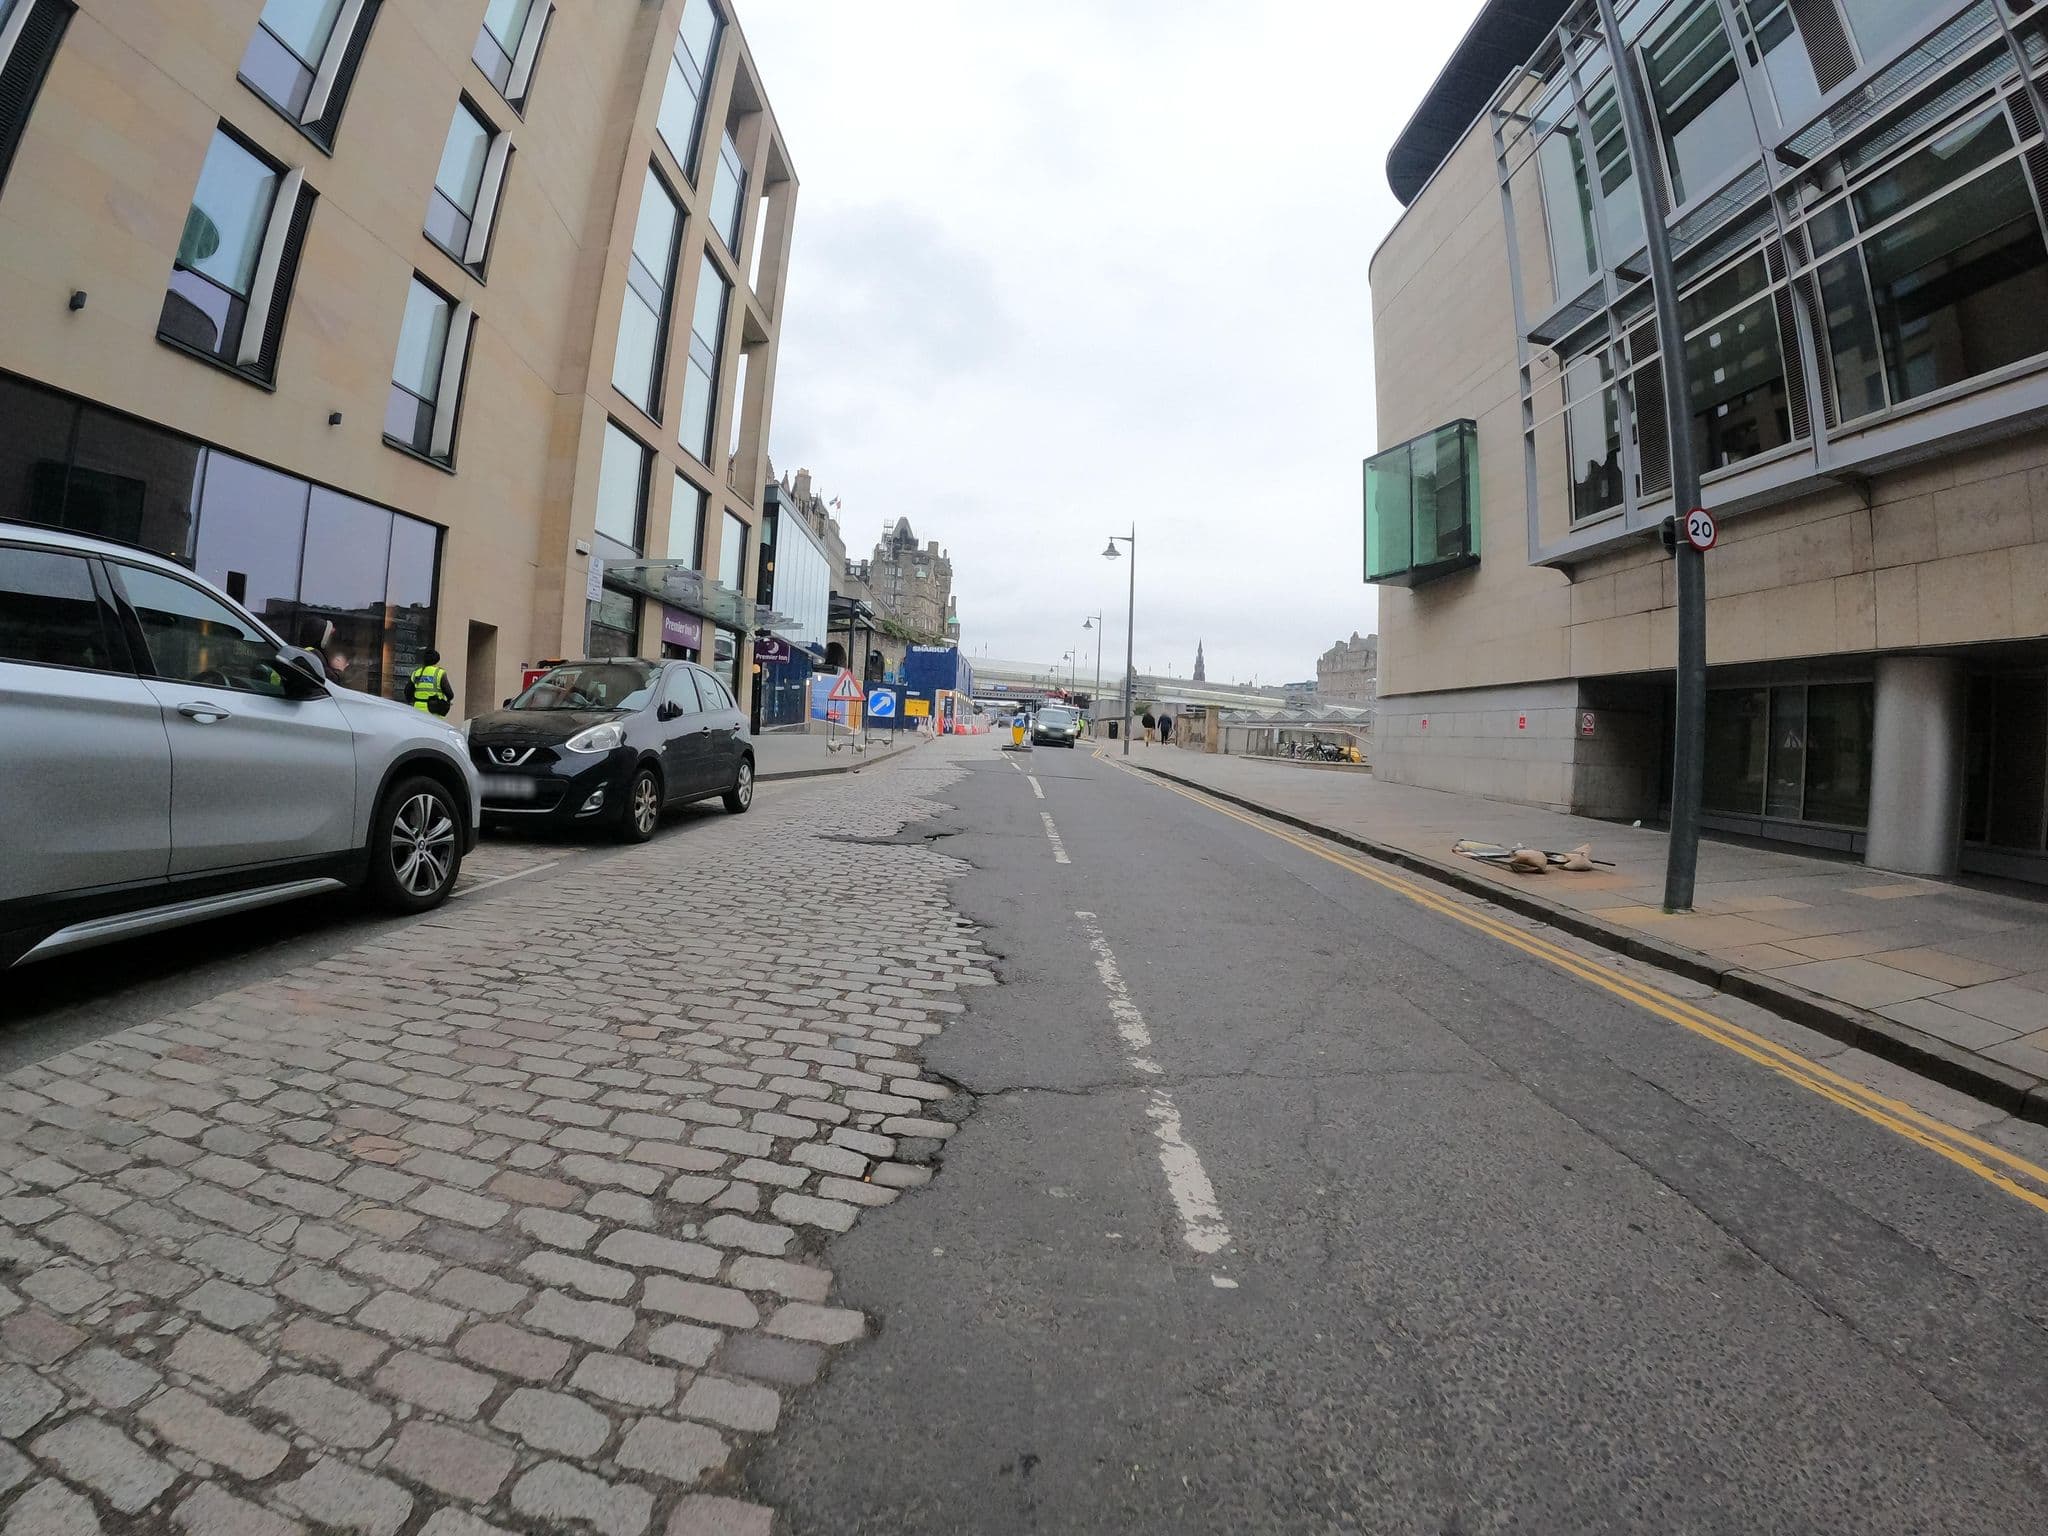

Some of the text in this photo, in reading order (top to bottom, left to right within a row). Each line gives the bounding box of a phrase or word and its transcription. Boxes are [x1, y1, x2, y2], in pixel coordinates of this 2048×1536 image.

[1690, 519, 1712, 538] 20
[665, 616, 692, 634] Premier Inn
[755, 652, 788, 661] Premier Inn
